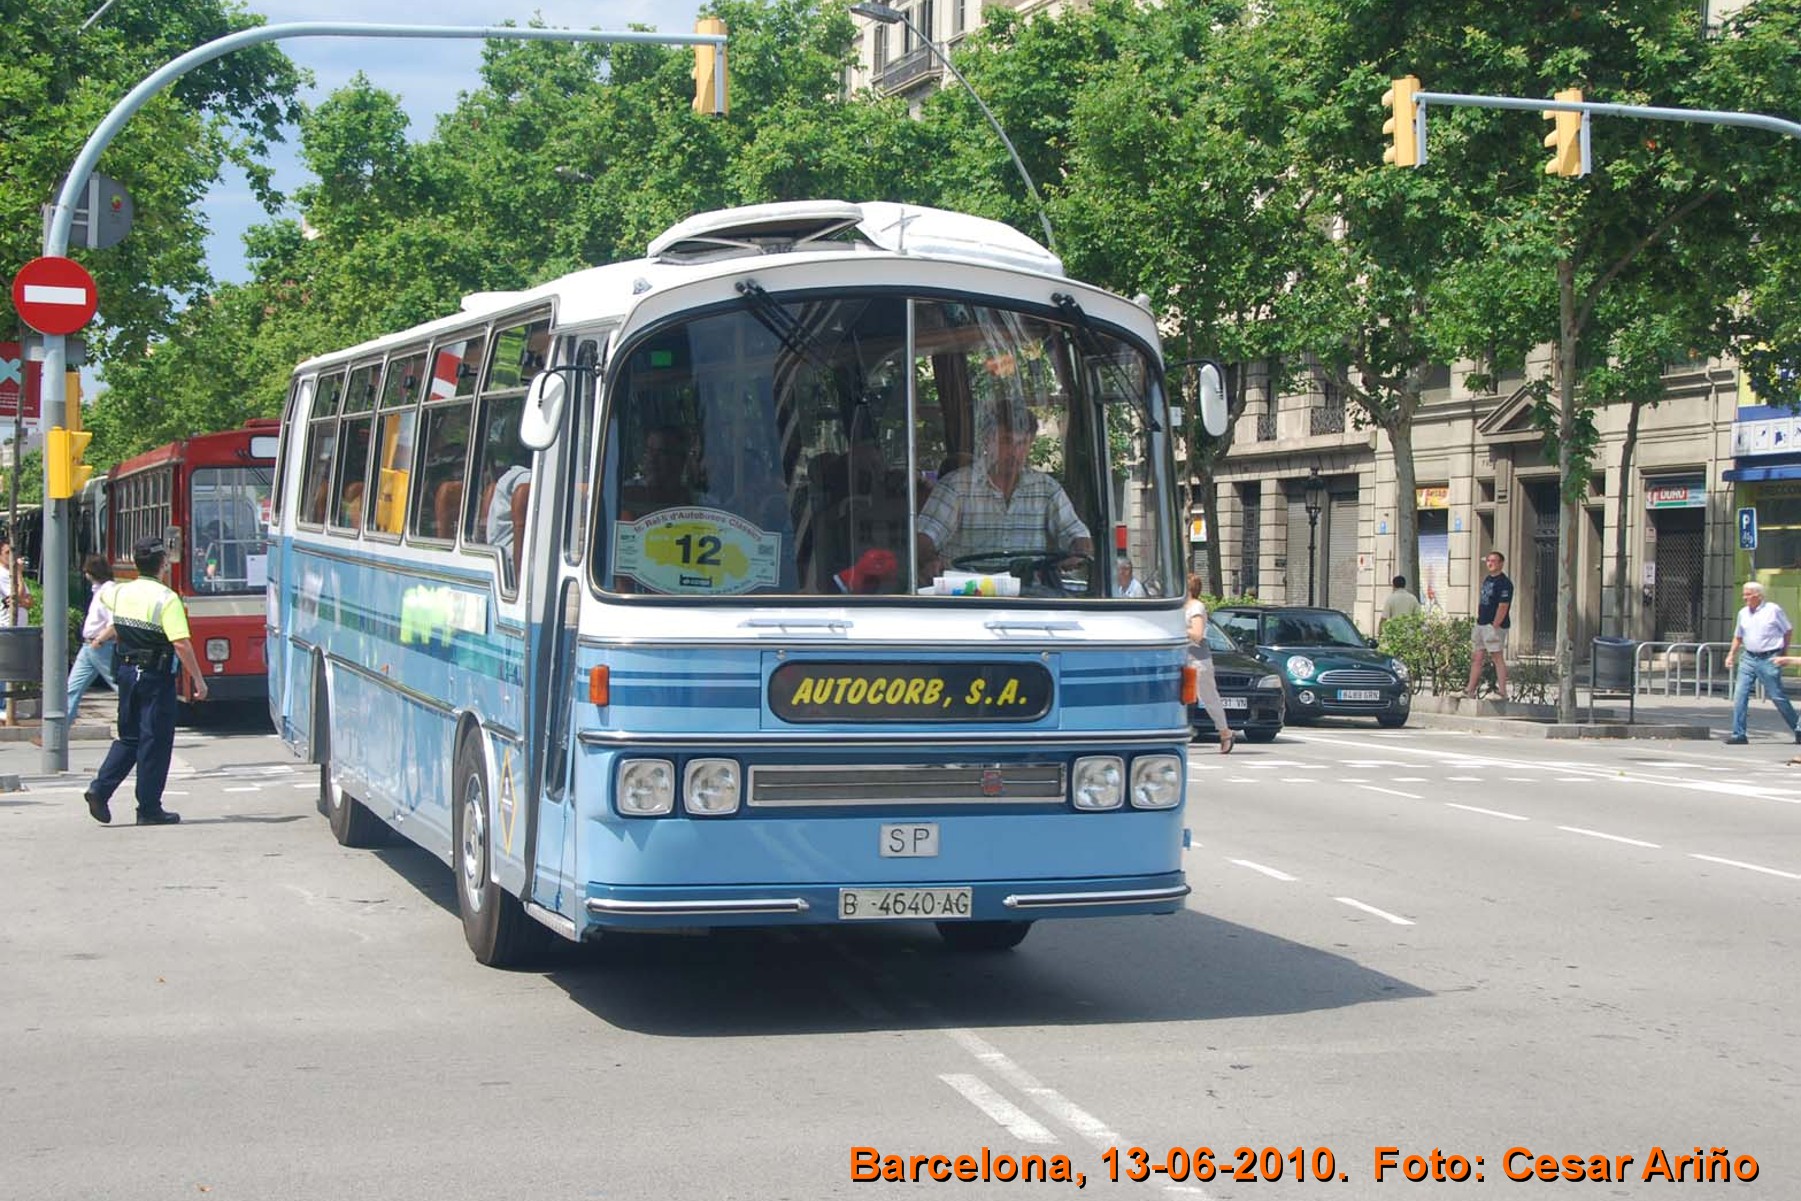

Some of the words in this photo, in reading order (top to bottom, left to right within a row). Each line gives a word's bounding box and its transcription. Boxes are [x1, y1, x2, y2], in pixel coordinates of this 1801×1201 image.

[1742, 513, 1751, 530] P
[675, 534, 722, 566] 12
[791, 677, 952, 708] AUTOCORB,
